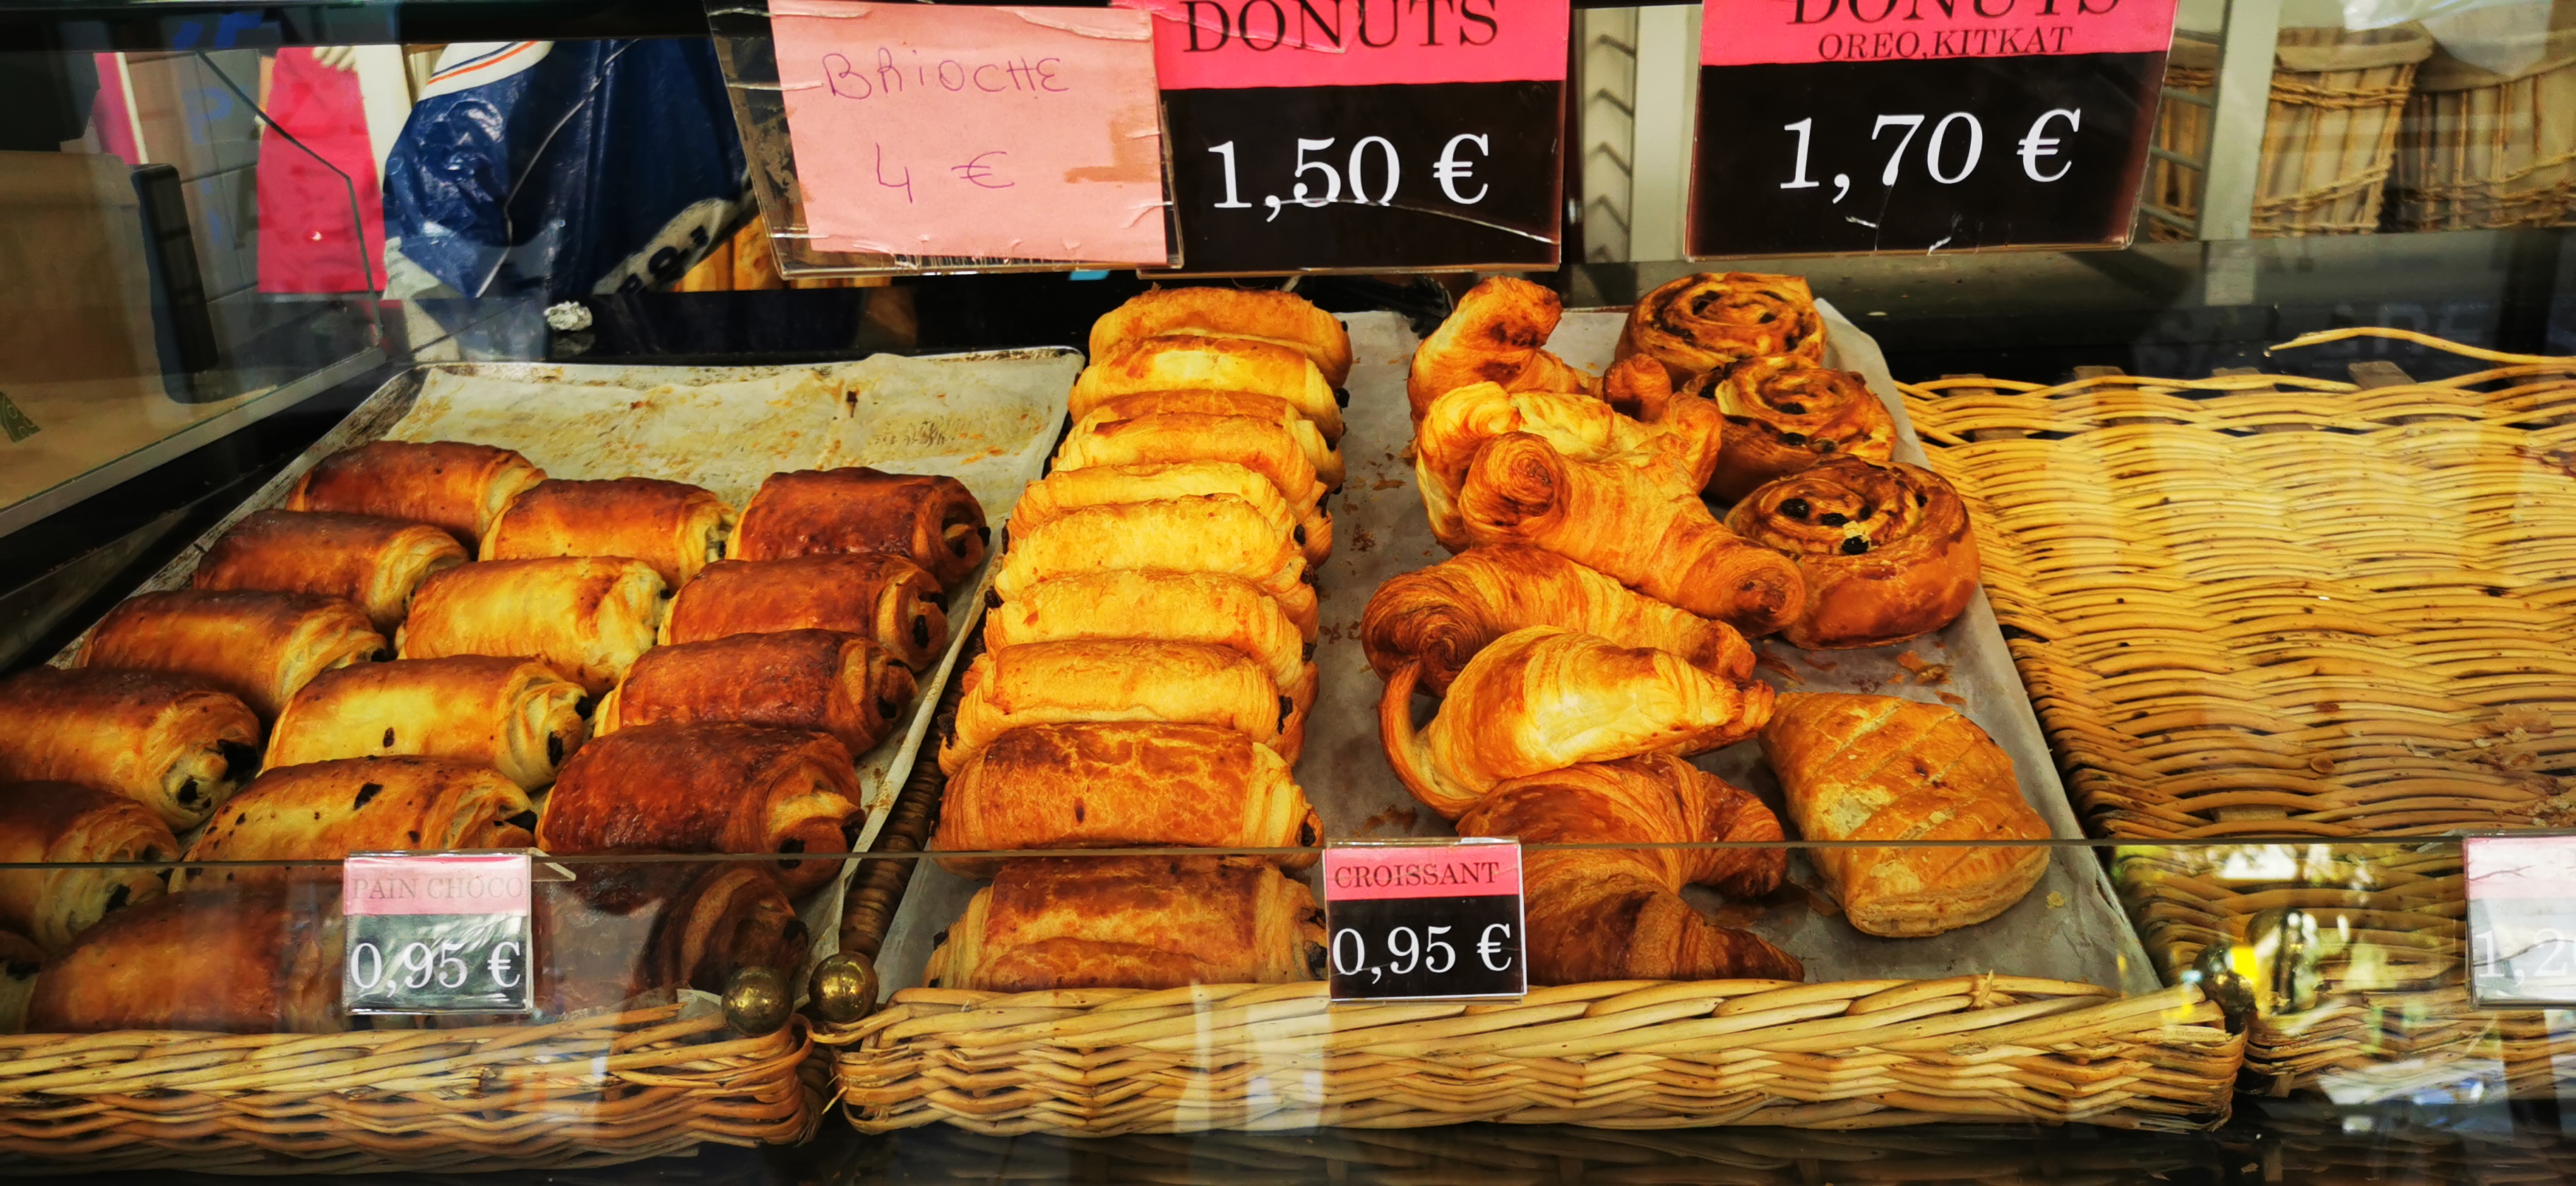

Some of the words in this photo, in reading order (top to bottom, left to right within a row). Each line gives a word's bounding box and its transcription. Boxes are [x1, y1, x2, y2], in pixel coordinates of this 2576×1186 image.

[1182, 0, 1498, 52] DONUTS
[1818, 26, 2073, 61] OREO,KITKAT
[874, 143, 913, 204] 4
[950, 150, 1015, 189] €
[1208, 135, 1400, 222] 1,50
[1432, 133, 1489, 205] €
[1779, 111, 1984, 205] 1,70
[2016, 107, 2081, 183] €
[352, 877, 419, 900] PAIN
[427, 877, 523, 899] CHOCO
[1335, 861, 1500, 889] CROISSANT
[350, 941, 468, 998] 0,95
[487, 941, 521, 988] €
[1332, 926, 1456, 985] 0,95
[1477, 923, 1512, 971] €
[2475, 927, 2576, 988] 1,2
